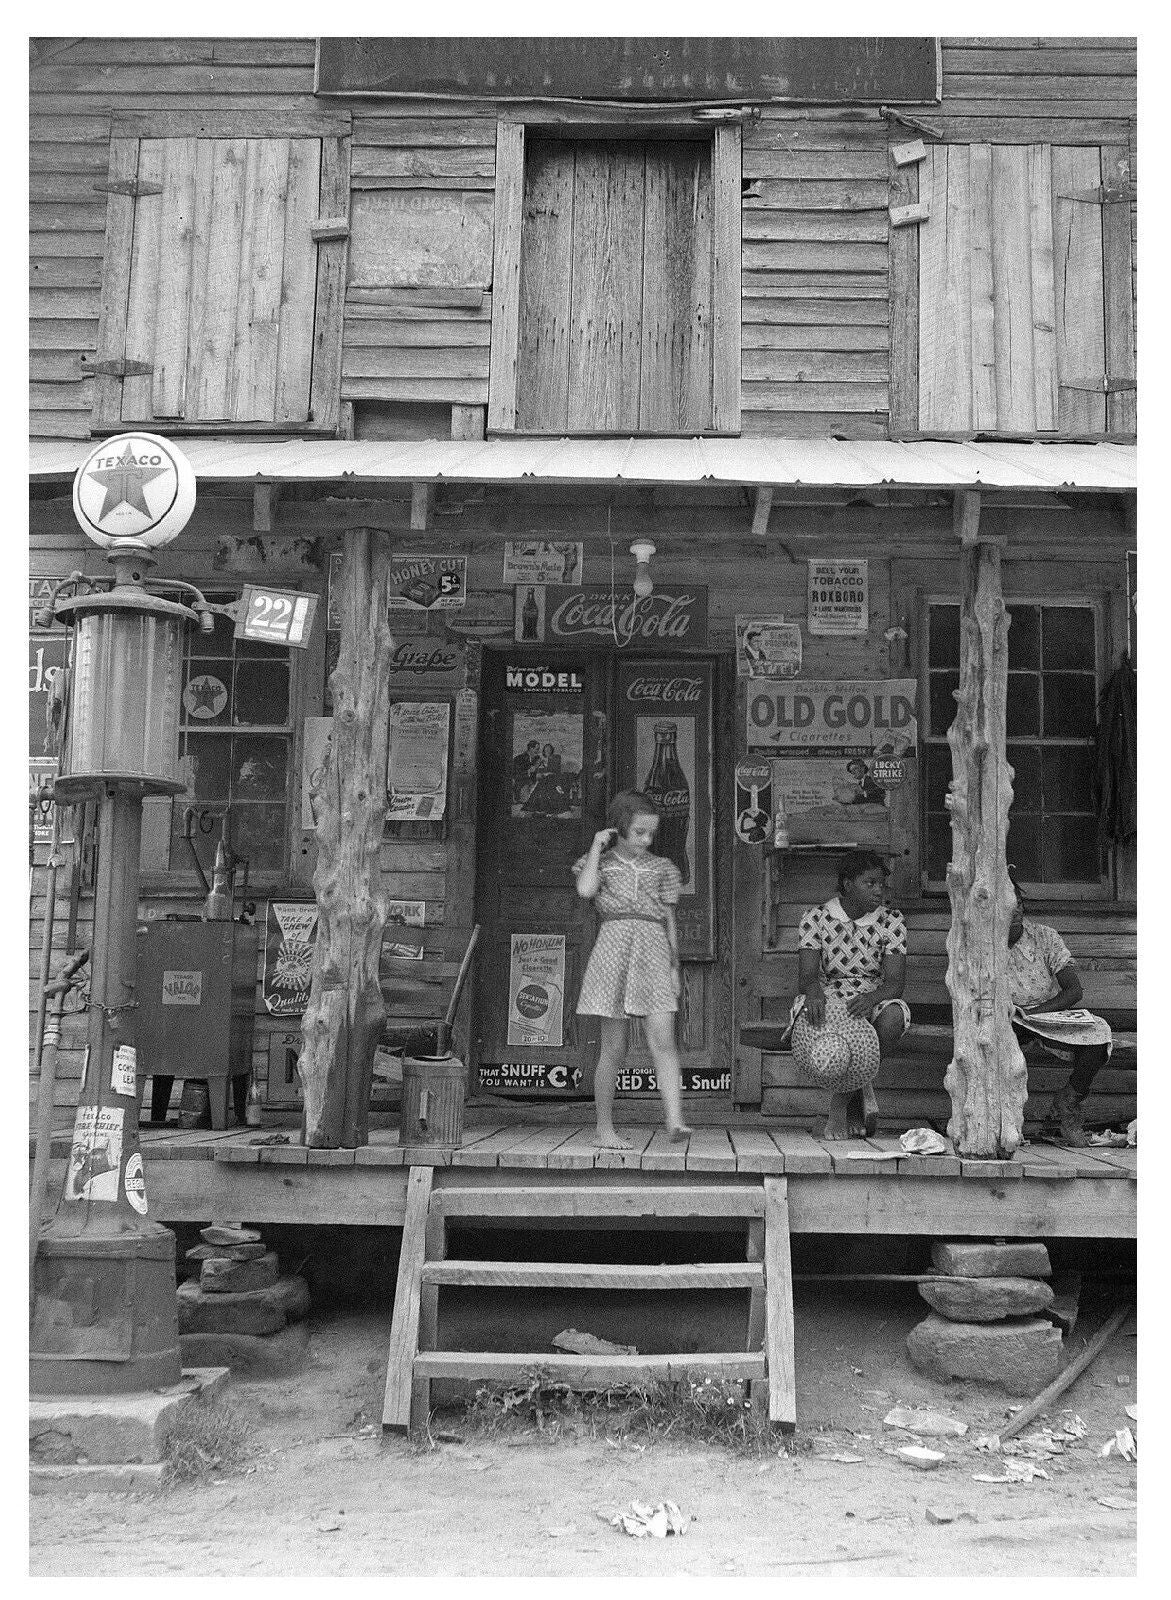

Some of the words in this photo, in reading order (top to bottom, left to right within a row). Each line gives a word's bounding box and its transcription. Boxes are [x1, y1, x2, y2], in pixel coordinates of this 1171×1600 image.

[96, 454, 161, 469] TEXACO
[391, 561, 436, 585] HONEY
[440, 559, 464, 572] CUT
[812, 577, 864, 586] TOBACCO
[812, 590, 864, 603] ROXBORO
[251, 596, 292, 629] 22
[551, 593, 697, 637] Coca-Cola
[392, 642, 457, 671] Grape
[506, 672, 582, 688] MODEL
[626, 677, 704, 702] Coca-Cola
[751, 694, 815, 728] OLD
[823, 694, 912, 729] GOLD
[789, 731, 853, 742] Cigarettes
[875, 761, 901, 769] LUCKY
[873, 769, 903, 778] STRIKE
[281, 915, 302, 923] TAKE
[306, 915, 313, 923] A
[283, 923, 310, 931] CHEW
[267, 992, 309, 1012] Quality
[480, 1069, 499, 1077] THAT
[501, 1064, 545, 1077] SNUFF
[480, 1078, 500, 1087] YOU
[504, 1079, 532, 1087] WANT
[535, 1079, 546, 1088] IS
[615, 1075, 644, 1090] RED
[647, 1075, 687, 1090] SL
[692, 1073, 731, 1090] Snuff
